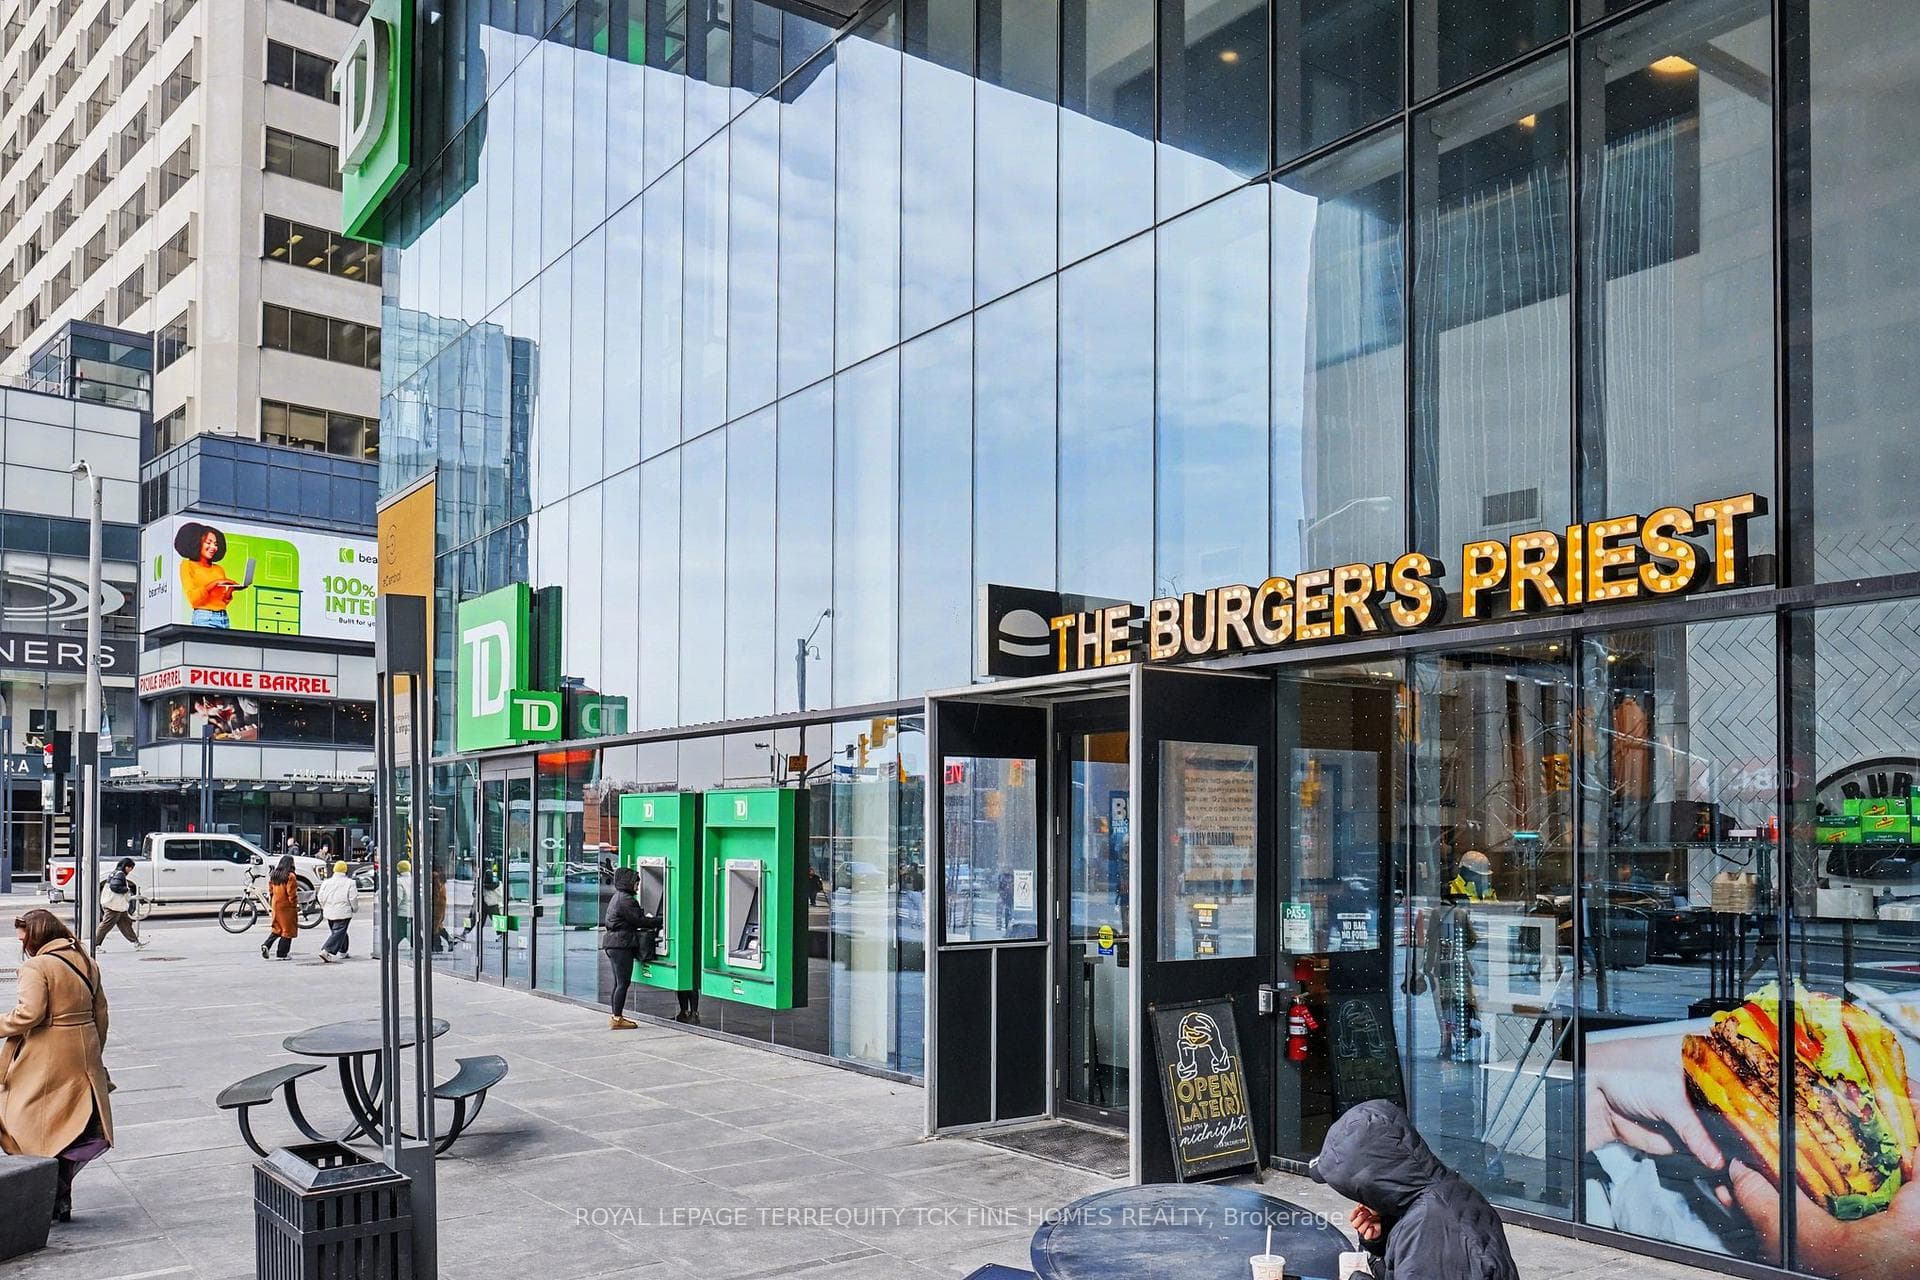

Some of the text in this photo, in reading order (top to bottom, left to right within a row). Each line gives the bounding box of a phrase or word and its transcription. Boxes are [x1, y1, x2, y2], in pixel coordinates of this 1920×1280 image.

[322, 575, 376, 598] 100%
[1051, 492, 1758, 672] THE BURGER'S PRIEST
[190, 669, 331, 694] PICKLE BARREL
[463, 620, 511, 718] TD
[513, 698, 559, 732] TD
[1111, 797, 1129, 821] B
[1286, 908, 1306, 919] PASS
[1342, 921, 1366, 930] NO BAG
[1176, 1071, 1238, 1103] OPEN
[1180, 1094, 1241, 1124] LATE(R)
[1179, 1115, 1248, 1148] midnight
